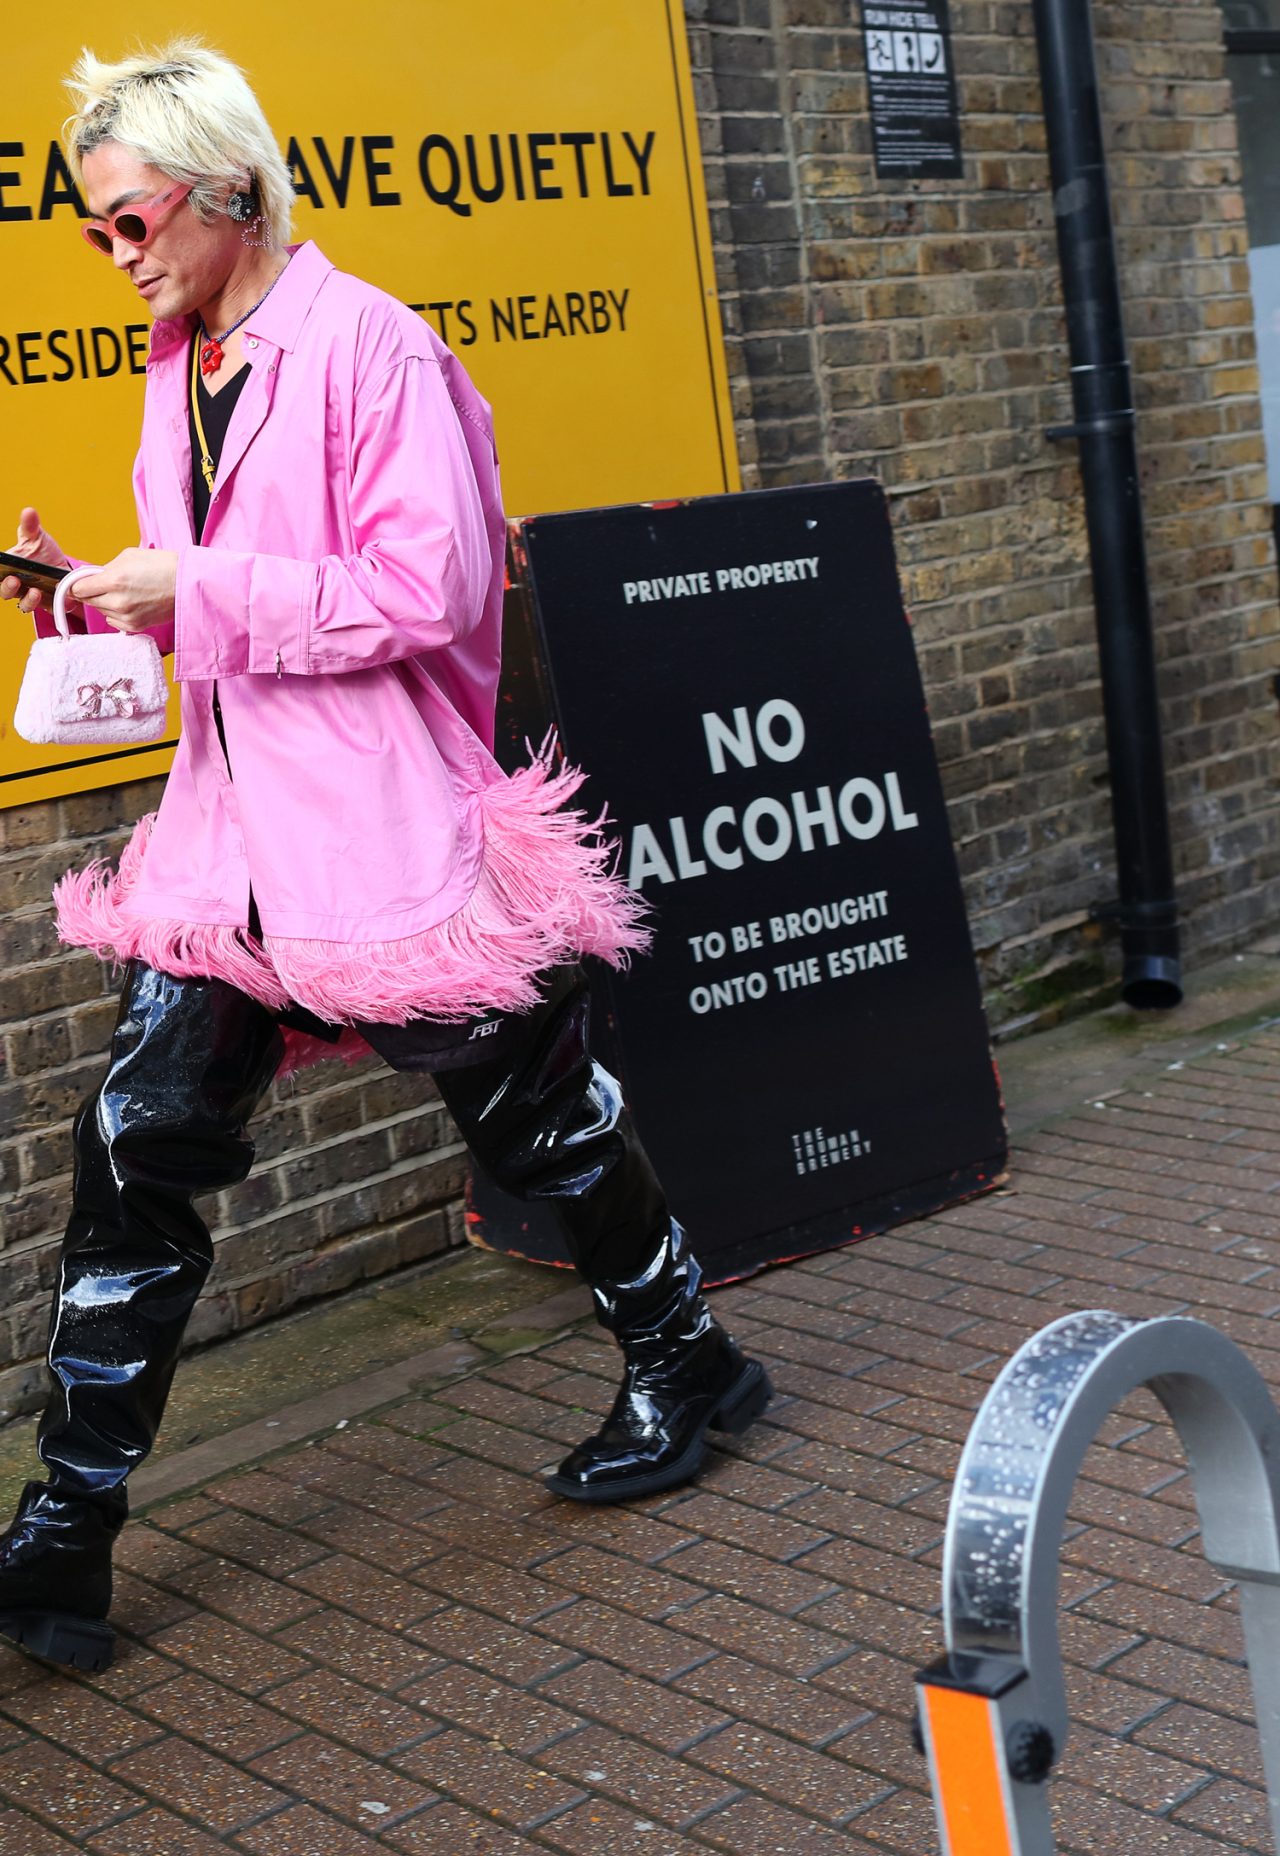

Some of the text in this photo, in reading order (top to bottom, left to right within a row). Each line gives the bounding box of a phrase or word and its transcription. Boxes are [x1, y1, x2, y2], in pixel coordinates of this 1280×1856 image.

[286, 135, 401, 209] AVE
[419, 131, 655, 217] QUIETLY
[490, 288, 629, 343] NEARBY
[623, 557, 819, 604] PRIVATE PROPERTY
[702, 698, 805, 774] NO
[628, 771, 918, 891] ALCOHOL
[688, 890, 888, 963] TO BE BROUGHT
[689, 934, 908, 1014] ONTO THE ESTATE
[792, 1127, 824, 1148] THE
